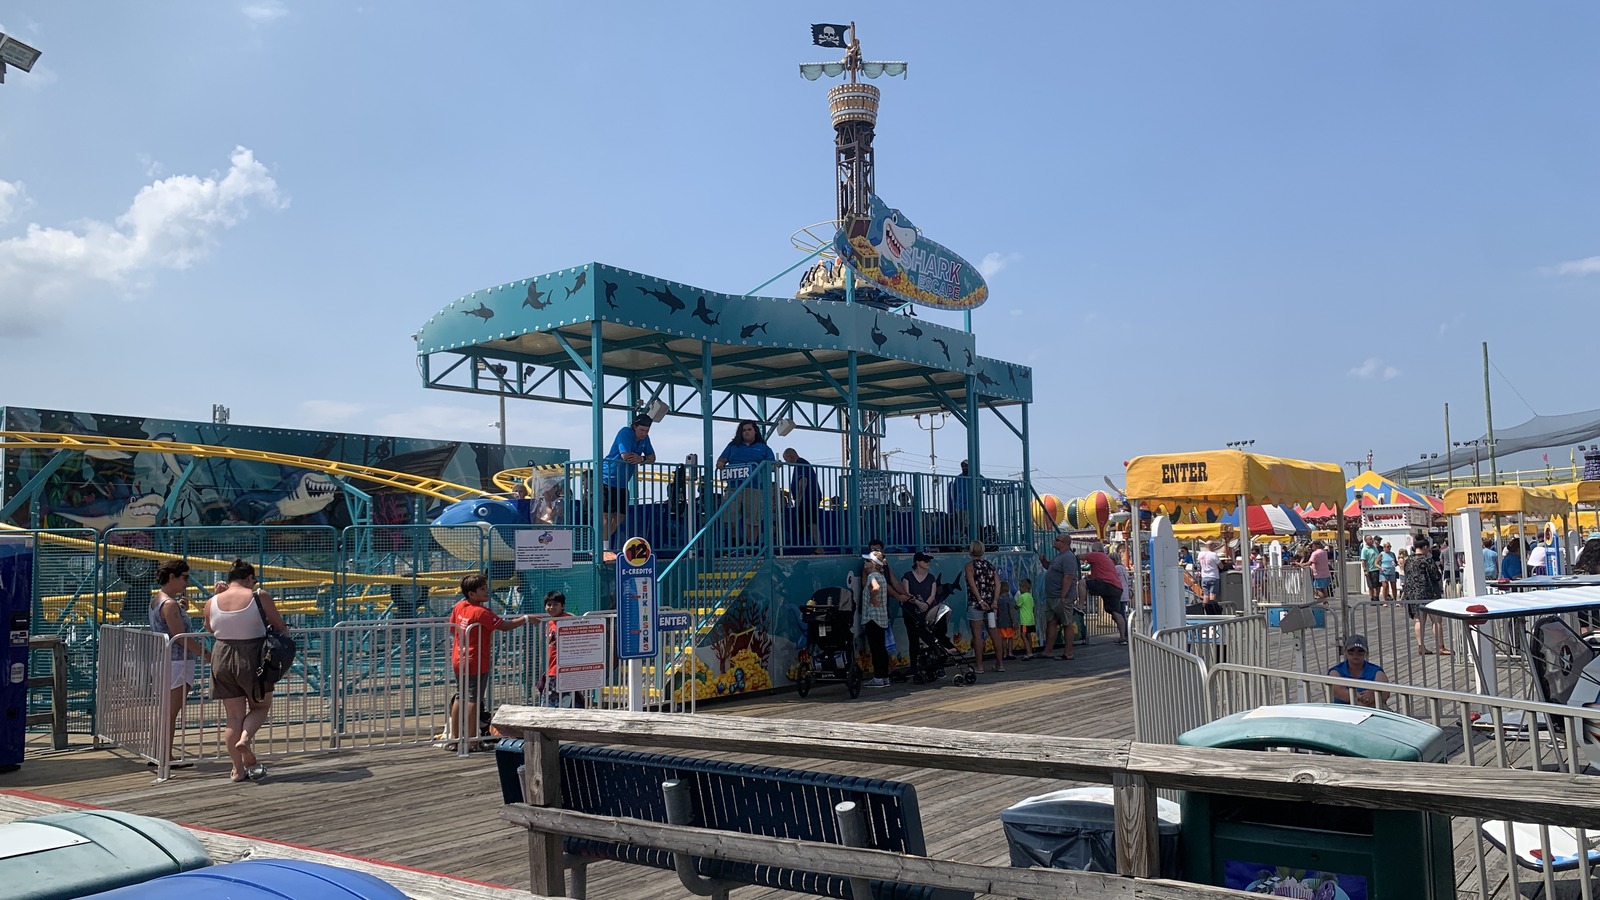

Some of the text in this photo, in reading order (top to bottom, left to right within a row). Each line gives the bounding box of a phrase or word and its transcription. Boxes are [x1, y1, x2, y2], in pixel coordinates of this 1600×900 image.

[900, 246, 962, 285] SHARK
[917, 273, 960, 301] ESCAPE
[721, 467, 750, 480] ENTER
[1162, 462, 1208, 483] ENTER
[1467, 491, 1499, 504] ENTER
[628, 543, 648, 559] 12
[659, 616, 688, 627] ENTER
